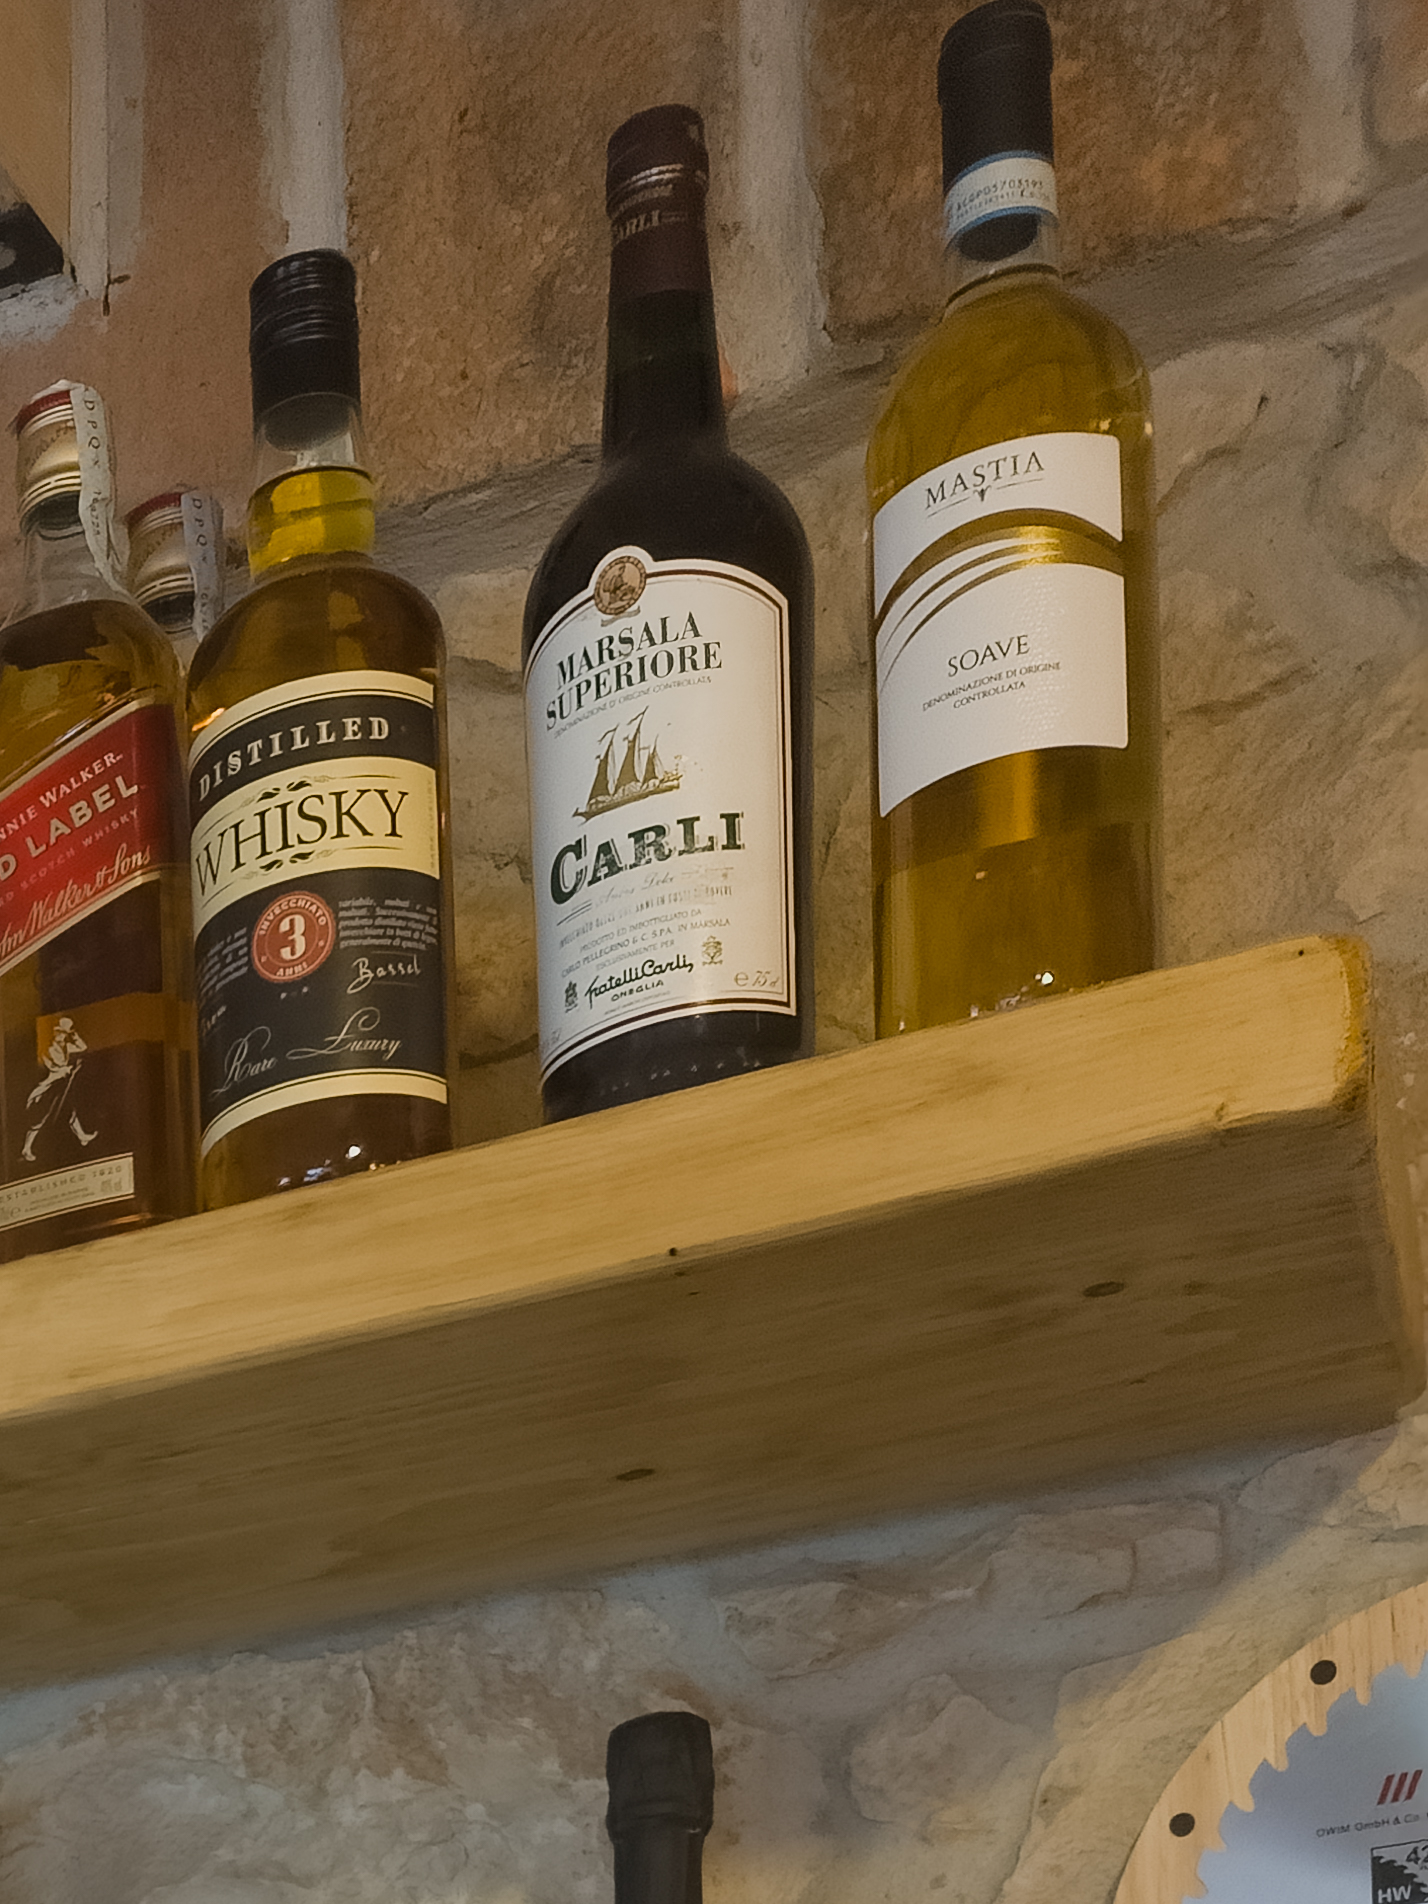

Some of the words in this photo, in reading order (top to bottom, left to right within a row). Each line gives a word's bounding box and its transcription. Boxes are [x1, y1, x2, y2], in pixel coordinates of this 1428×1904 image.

[924, 451, 1045, 510] MASTIA
[556, 610, 703, 690] MARSALA
[946, 634, 1030, 678] SOAVE
[545, 641, 723, 731] SUPERIORE
[921, 671, 1003, 712] DENOMINAZIONE
[1005, 669, 1016, 679] DI
[1017, 661, 1062, 676] ORIGINE
[952, 681, 1026, 709] CONTROLLATA
[38, 751, 120, 808] WALKER
[198, 715, 392, 802] DISTILLED
[24, 782, 139, 856] LABEL
[195, 788, 409, 897] WHISKY
[547, 810, 745, 907] CARLI
[26, 878, 94, 938] Walker
[104, 843, 151, 886] Sons
[276, 912, 305, 961] 3
[609, 978, 664, 1002] ONEGLIA
[1376, 1884, 1413, 1904] HW
